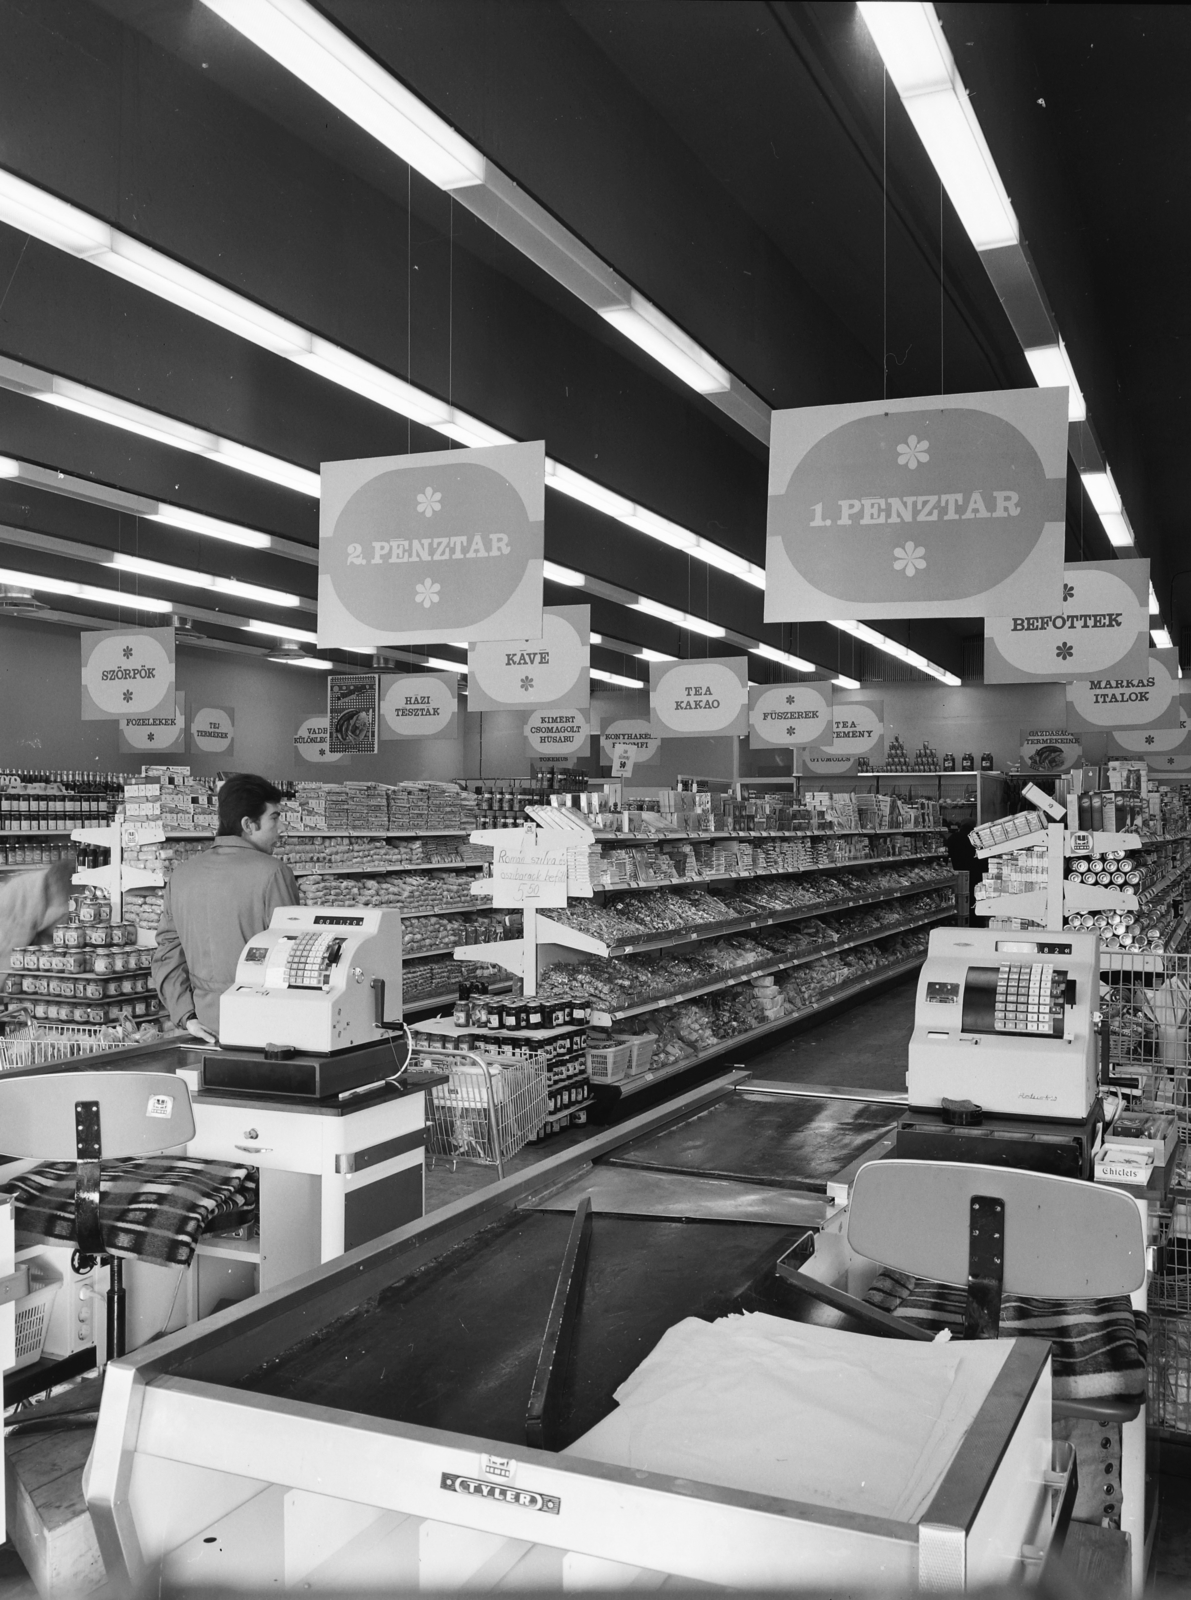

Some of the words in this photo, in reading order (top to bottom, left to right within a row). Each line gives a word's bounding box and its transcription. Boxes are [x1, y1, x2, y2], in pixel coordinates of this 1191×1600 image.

[810, 501, 831, 527] 1.
[837, 489, 1021, 526] PÉNZTÁR
[347, 542, 367, 566] 2.
[371, 532, 511, 564] PÉNZTÁR
[101, 665, 156, 681] SZÖRPÖK
[685, 686, 713, 697] TEA
[1093, 691, 1149, 704] ITALOK
[674, 699, 720, 711] KAKAO
[530, 725, 582, 734] CSOMAGOLT
[530, 850, 557, 865] szilva
[1102, 1167, 1139, 1178] Chiclets
[467, 1481, 531, 1506] TYLER
